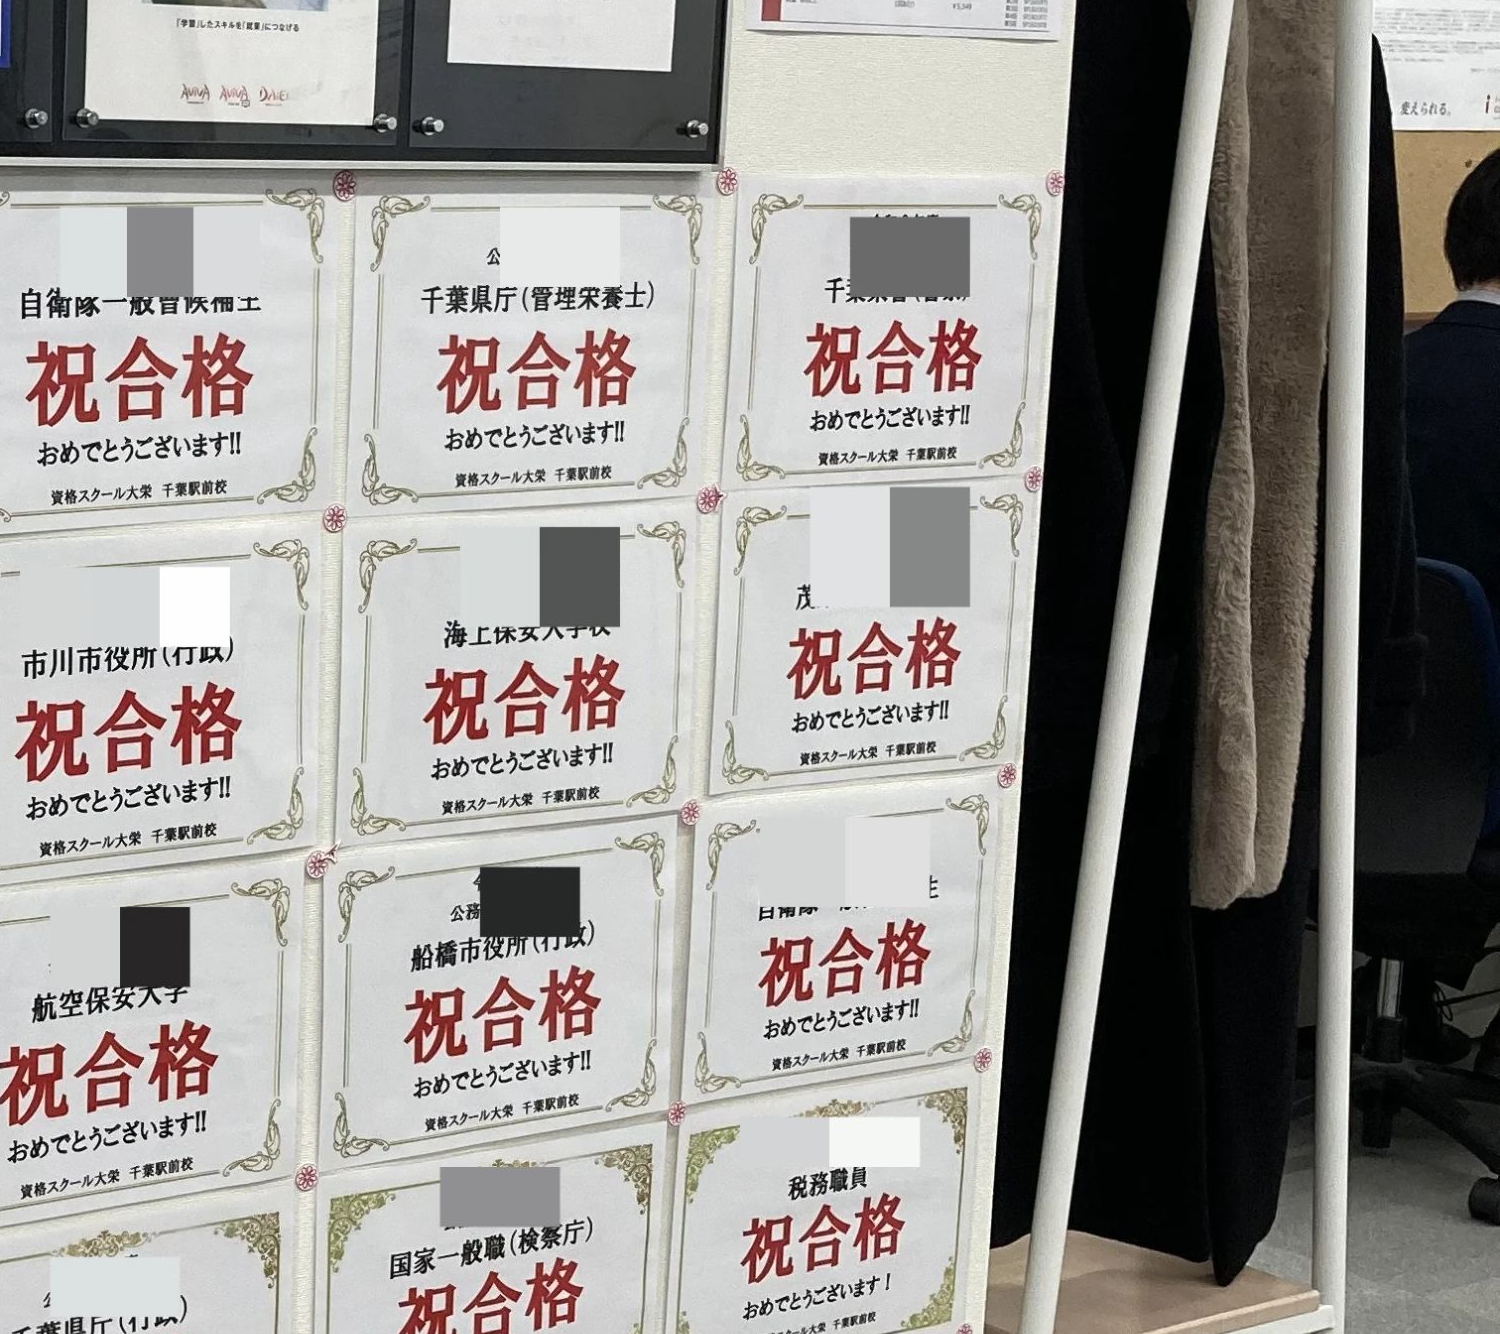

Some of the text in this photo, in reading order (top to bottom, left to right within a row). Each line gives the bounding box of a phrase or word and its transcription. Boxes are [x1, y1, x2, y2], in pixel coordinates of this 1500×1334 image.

[26, 332, 253, 427] 祝合格
[803, 318, 982, 398] 祝合格
[50, 479, 227, 506] 資格スクール大栄 千葉駅前校
[423, 653, 626, 745] 祝合格
[758, 918, 931, 1008] 祝合格
[788, 1167, 867, 1200] 税務職員
